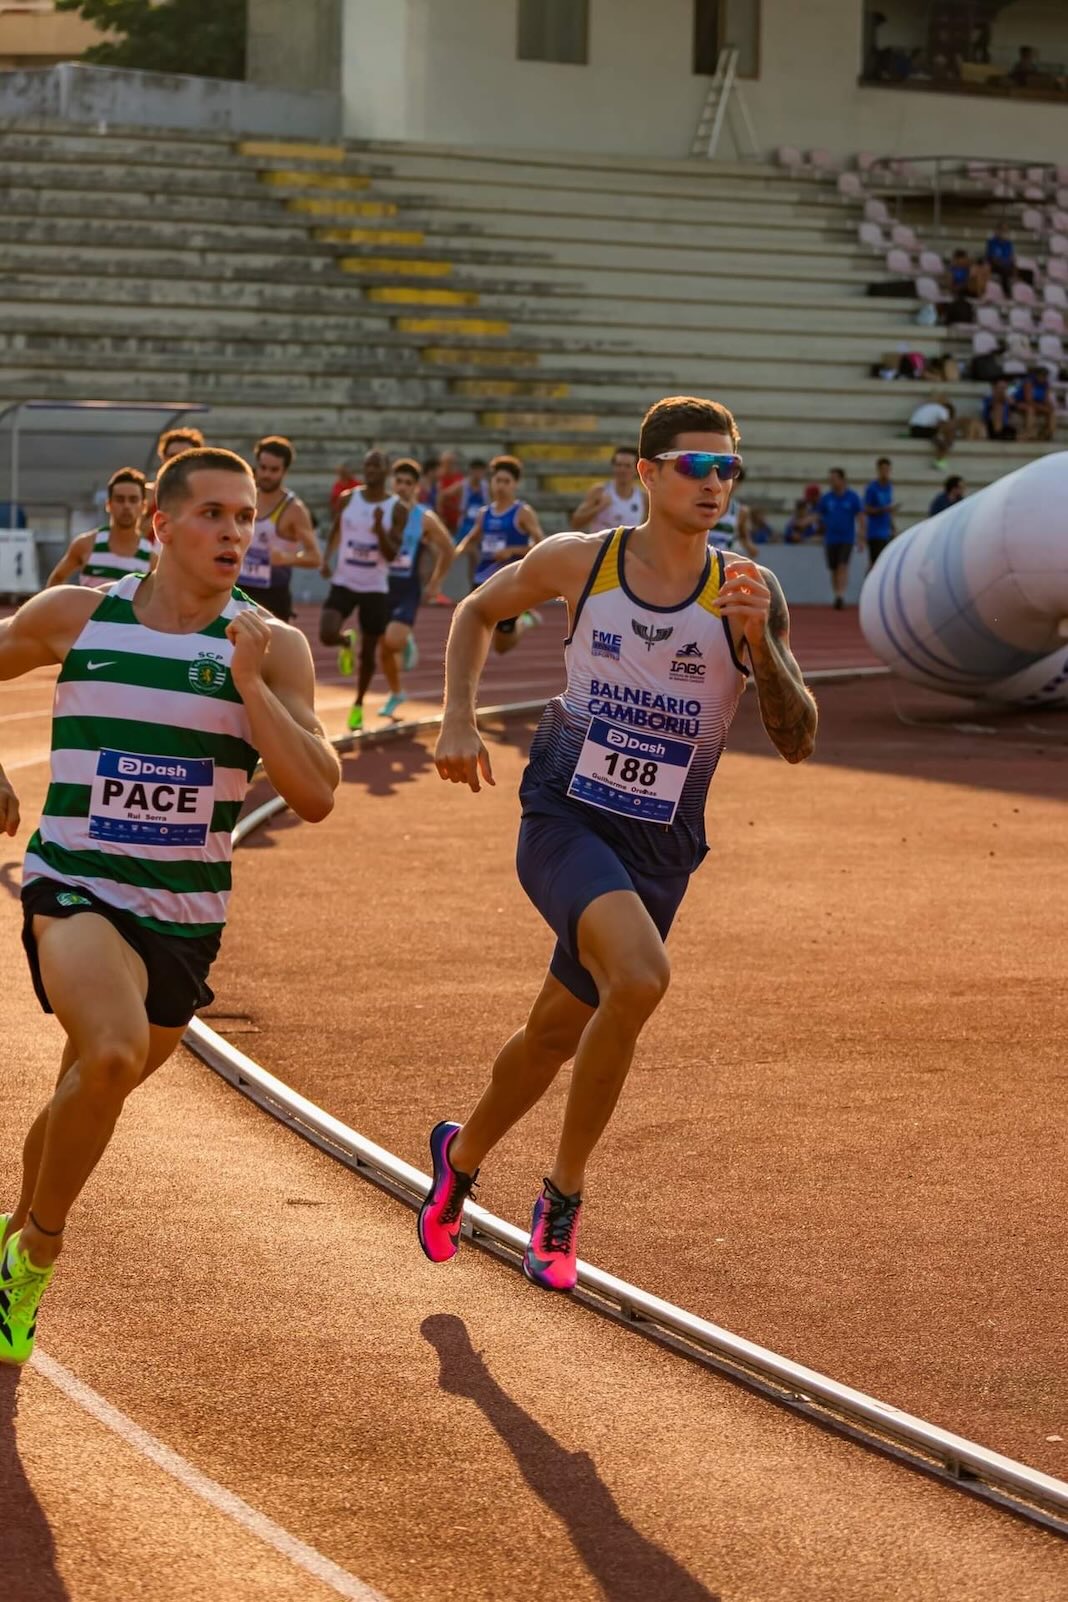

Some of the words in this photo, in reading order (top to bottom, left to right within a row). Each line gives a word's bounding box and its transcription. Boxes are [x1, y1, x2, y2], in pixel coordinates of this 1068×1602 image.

[592, 629, 622, 647] FME
[670, 660, 707, 676] IABC
[590, 679, 702, 717] BALNEÁRIO
[588, 698, 700, 738] CAMBORIÚ
[627, 737, 666, 756] Dash
[142, 762, 187, 777] Dash
[605, 752, 658, 787] 188
[102, 779, 199, 813] PACE
[127, 812, 141, 820] Rui
[145, 814, 167, 822] Serra
